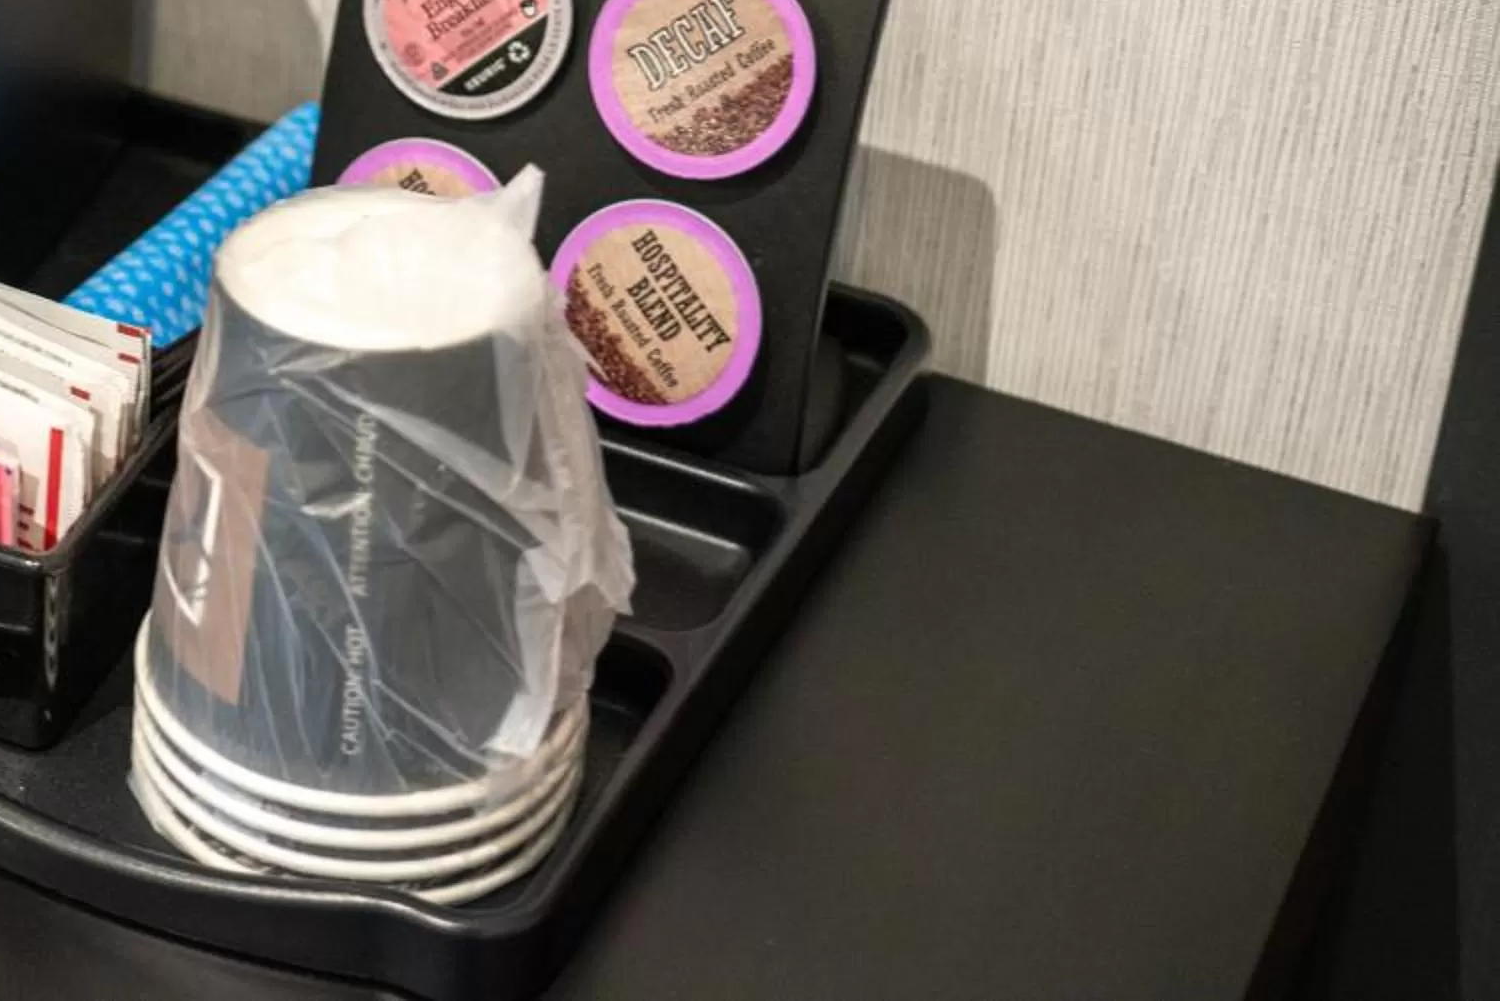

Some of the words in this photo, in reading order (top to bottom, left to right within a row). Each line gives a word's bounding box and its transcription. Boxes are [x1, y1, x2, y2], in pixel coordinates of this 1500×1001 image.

[648, 95, 686, 124] Fresh
[684, 60, 737, 99] Roasted
[735, 38, 777, 69] Coffee
[587, 262, 615, 300] Fresh
[611, 298, 654, 348] Roasted
[647, 348, 680, 388] Coffee
[626, 275, 683, 342] BLEND
[631, 229, 732, 353] HOSPITALITY
[344, 623, 366, 665] HOT
[340, 674, 364, 756] CAUTION
